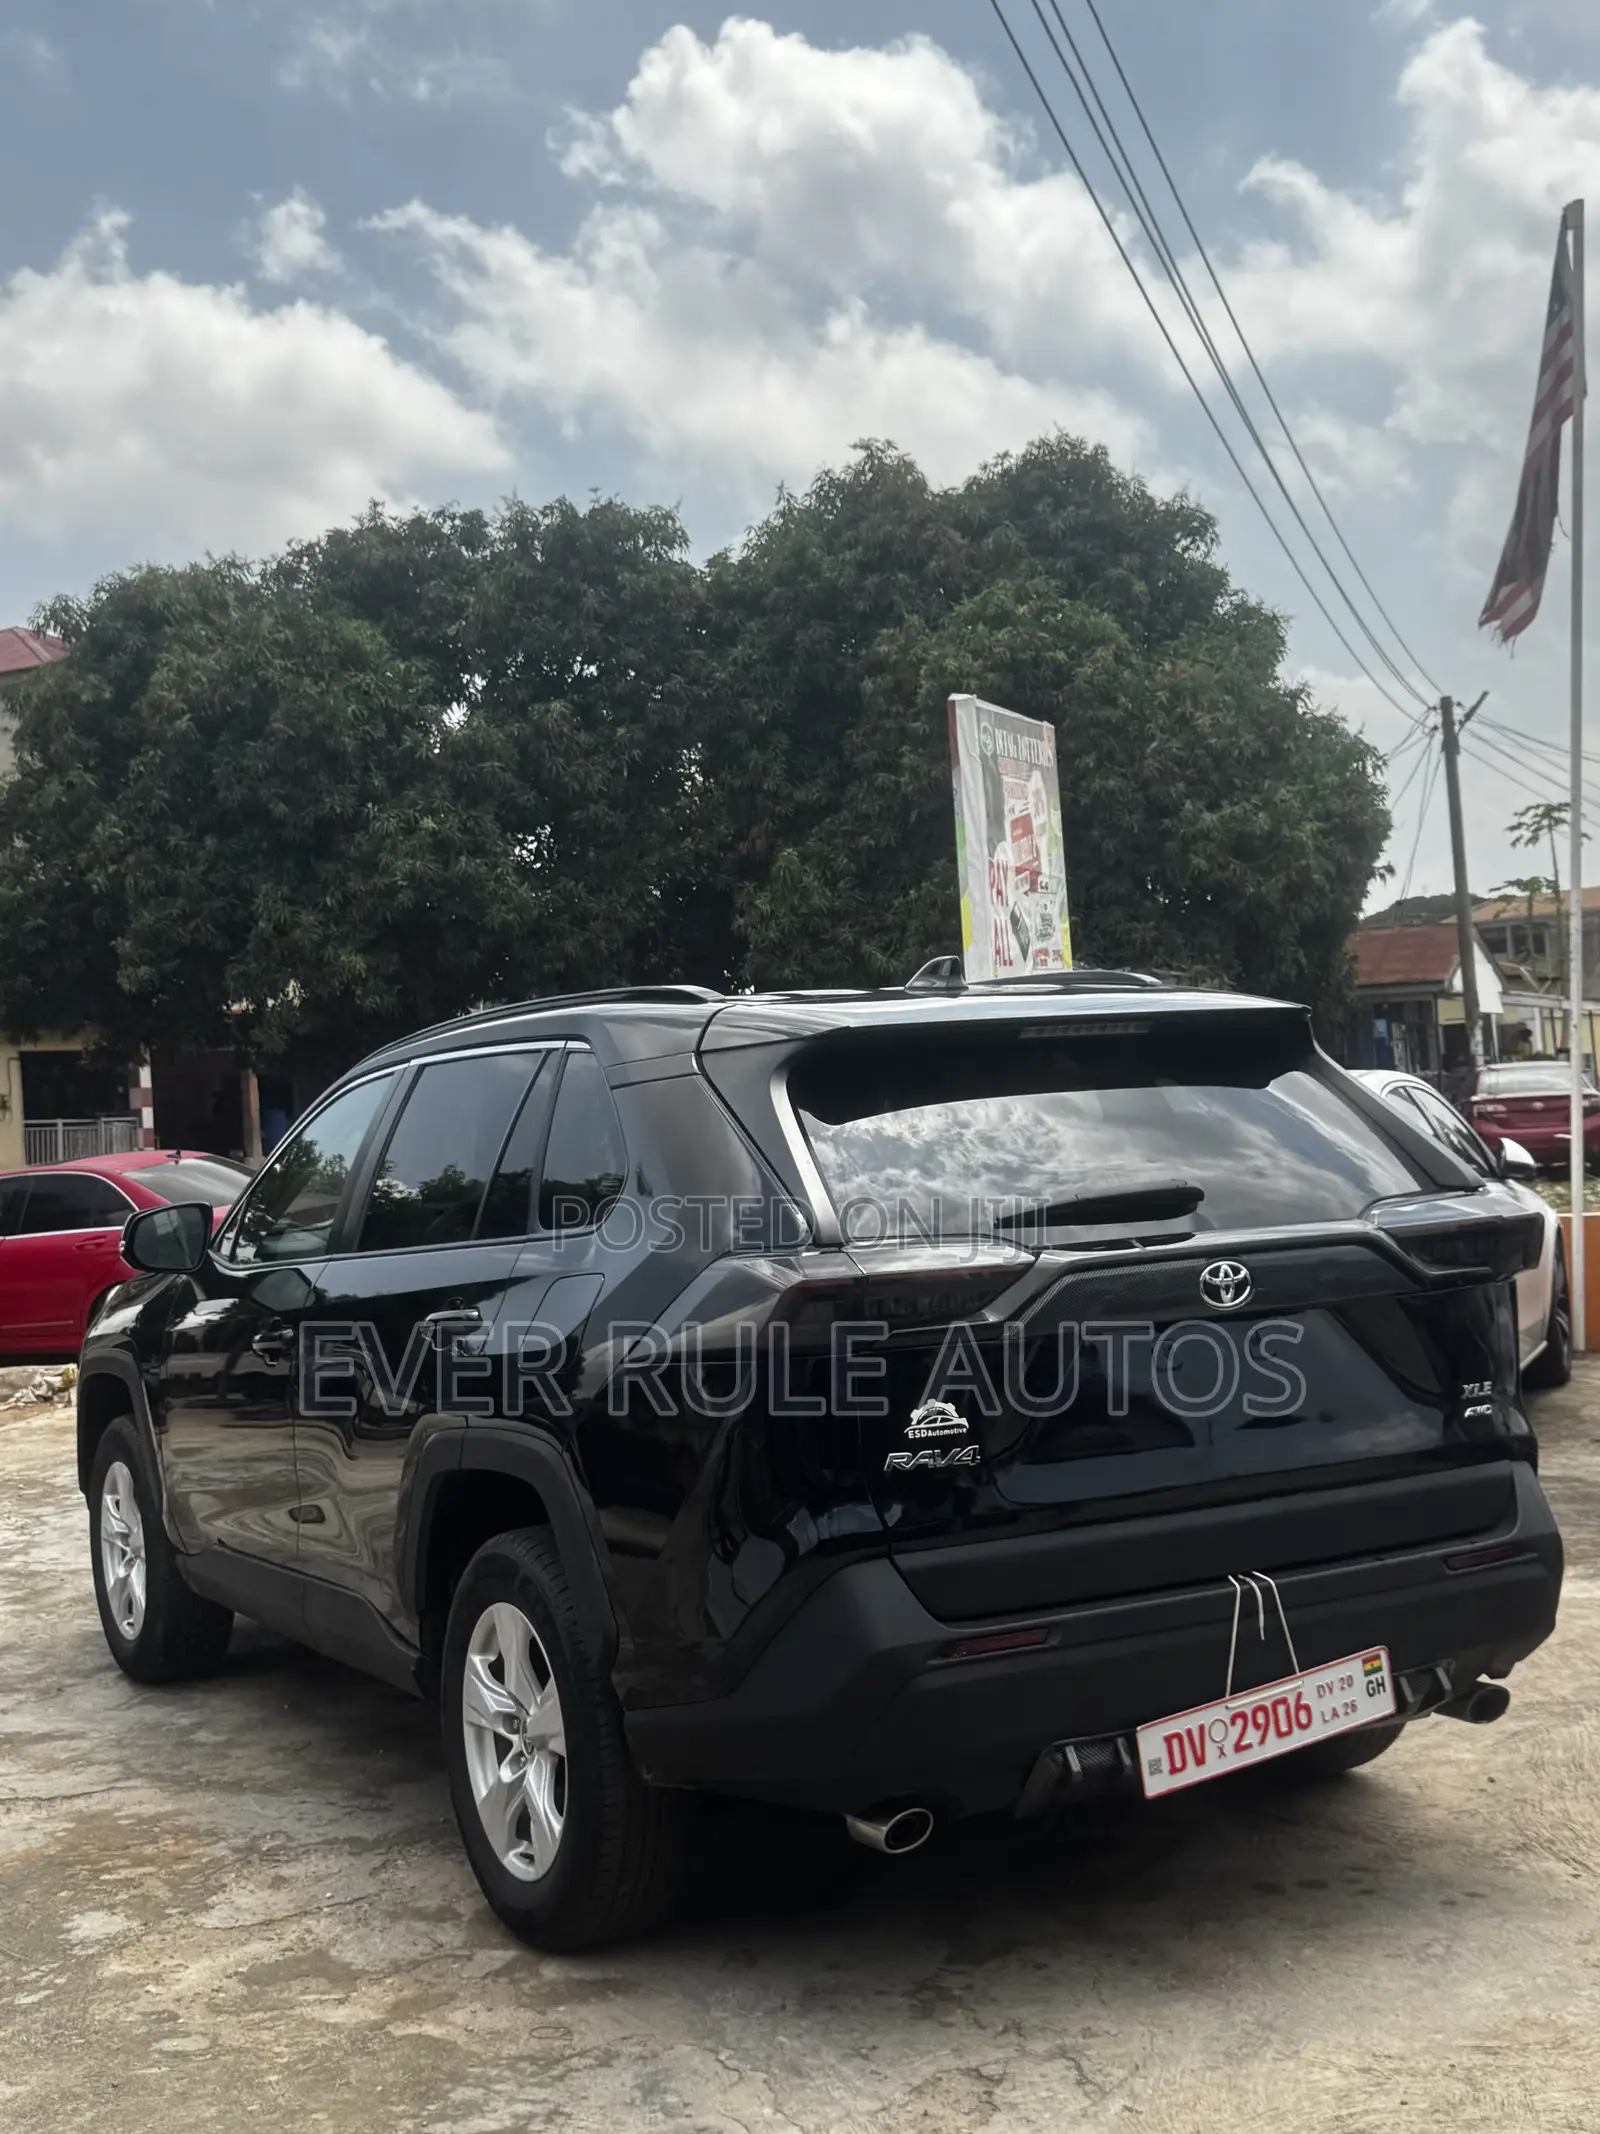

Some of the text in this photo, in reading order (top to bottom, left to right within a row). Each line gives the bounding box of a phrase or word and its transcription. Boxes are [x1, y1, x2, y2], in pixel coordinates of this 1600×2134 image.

[988, 858, 1009, 907] PAY
[993, 917, 1014, 967] ALL
[1460, 1381, 1492, 1399] XLE
[884, 1445, 980, 1471] RAV4
[1316, 1673, 1354, 1698] DV 20
[1365, 1675, 1387, 1698] GH
[1320, 1705, 1341, 1724] LA
[1163, 1690, 1313, 1776] DV 2906
